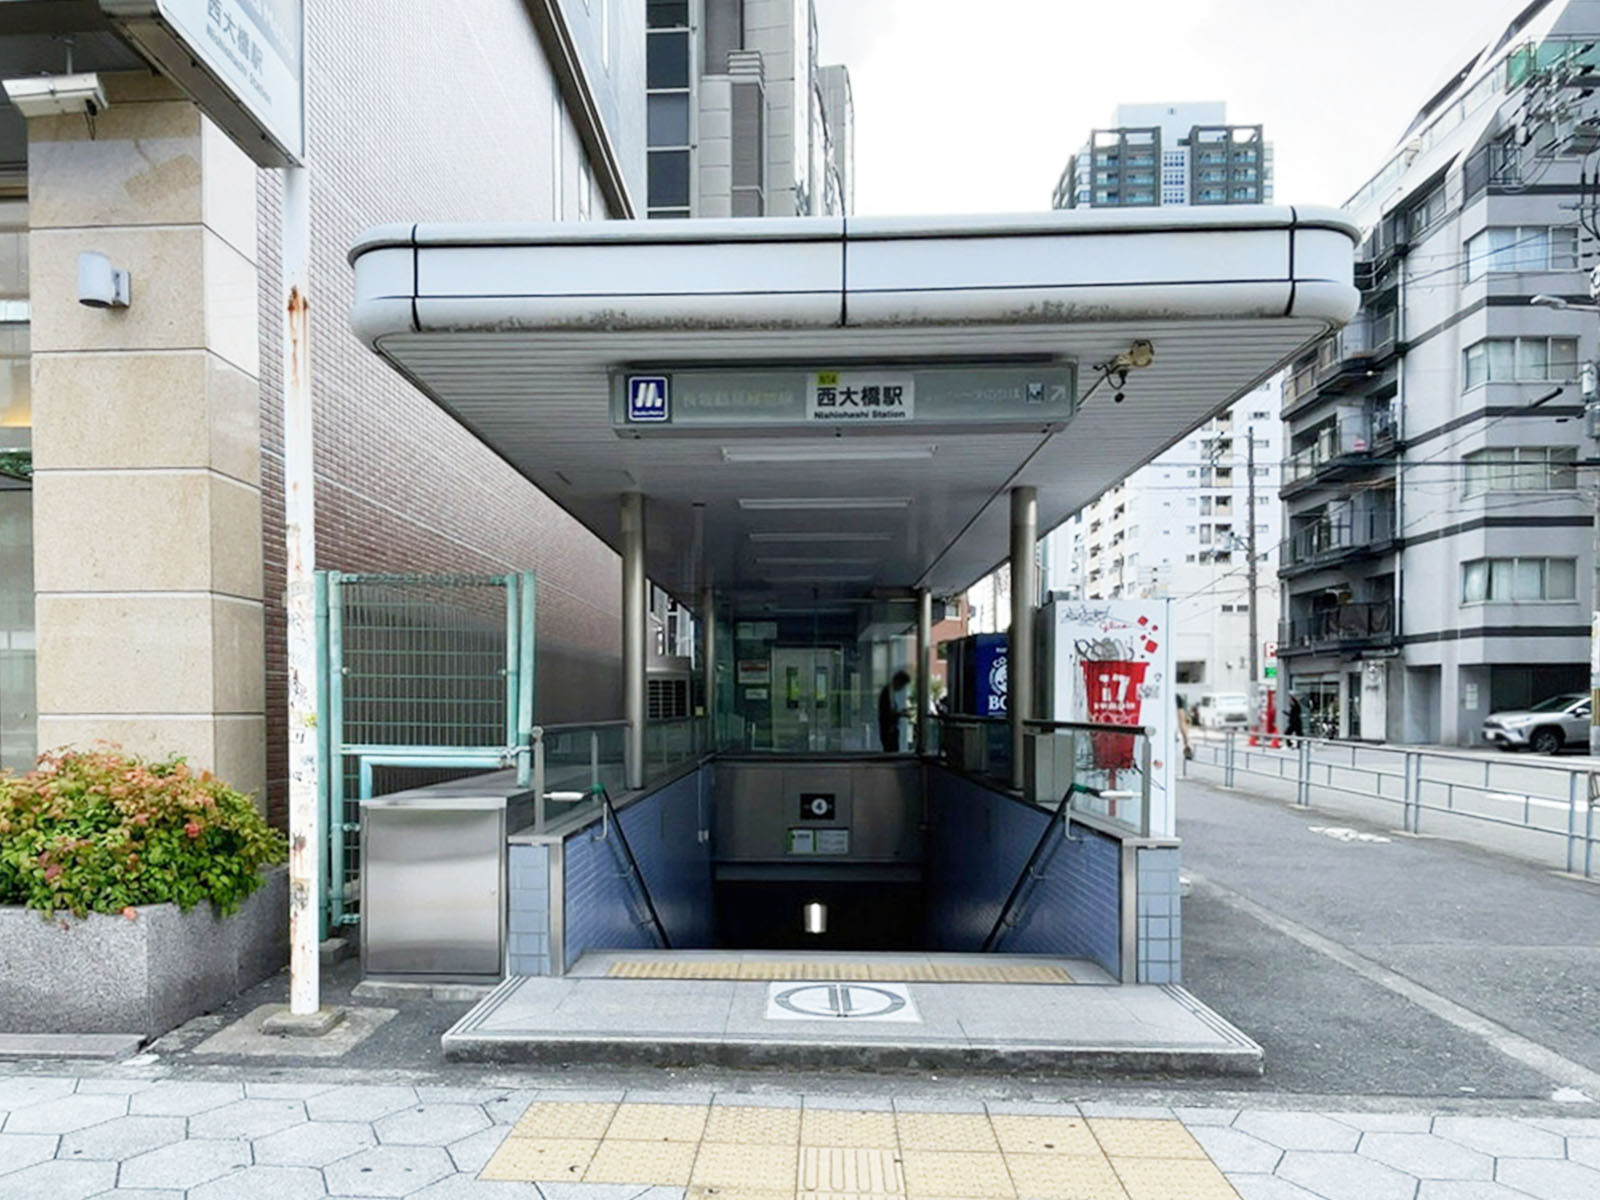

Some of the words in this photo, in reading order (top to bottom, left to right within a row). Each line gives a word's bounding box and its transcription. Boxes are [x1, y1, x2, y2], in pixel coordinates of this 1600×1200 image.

[816, 386, 904, 407] 西大橋駅
[813, 410, 870, 420] Nishiohashi
[872, 410, 906, 419] Station
